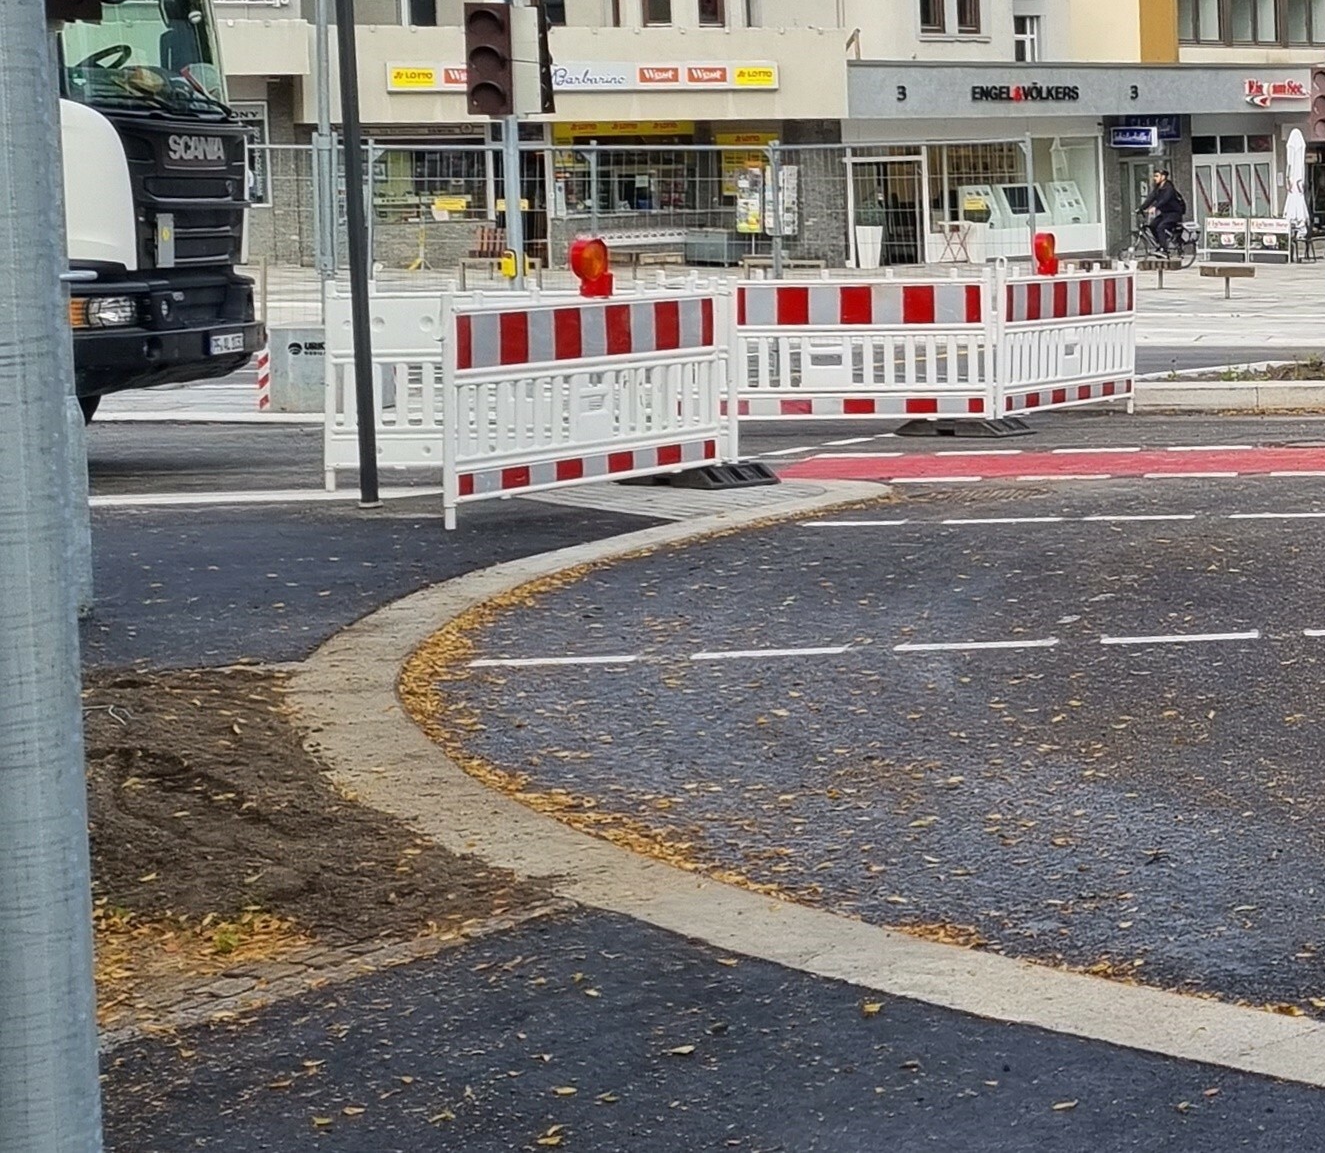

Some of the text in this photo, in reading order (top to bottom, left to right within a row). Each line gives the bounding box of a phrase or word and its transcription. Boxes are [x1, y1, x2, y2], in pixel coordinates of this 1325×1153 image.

[554, 68, 625, 85] Barbarino
[897, 85, 907, 101] 3
[1130, 85, 1139, 100] 3
[168, 134, 226, 160] SCANIA
